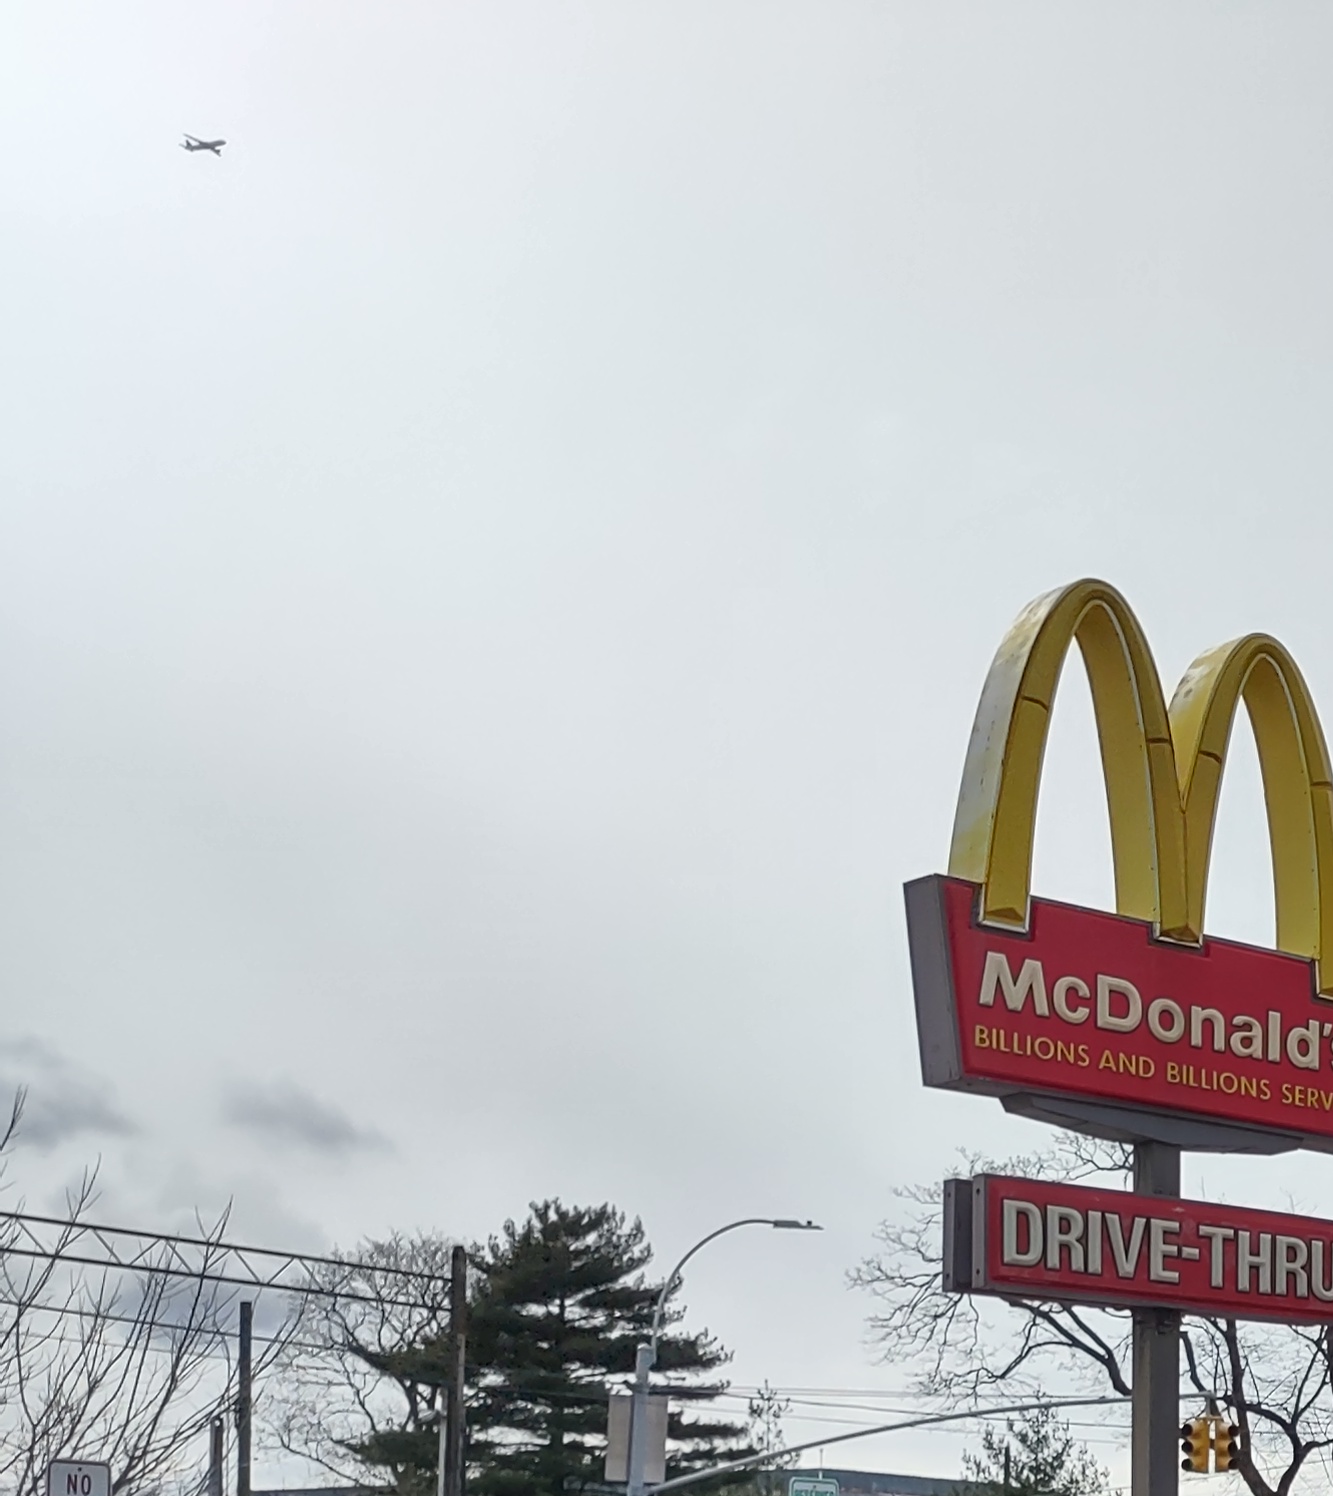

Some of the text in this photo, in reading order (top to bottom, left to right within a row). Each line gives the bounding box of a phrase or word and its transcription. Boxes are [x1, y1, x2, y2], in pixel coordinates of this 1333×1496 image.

[974, 1025, 1090, 1067] BILLIONS
[1099, 1051, 1155, 1079] AND
[1166, 1063, 1271, 1101] BILLIONS
[66, 1473, 92, 1496] NO
